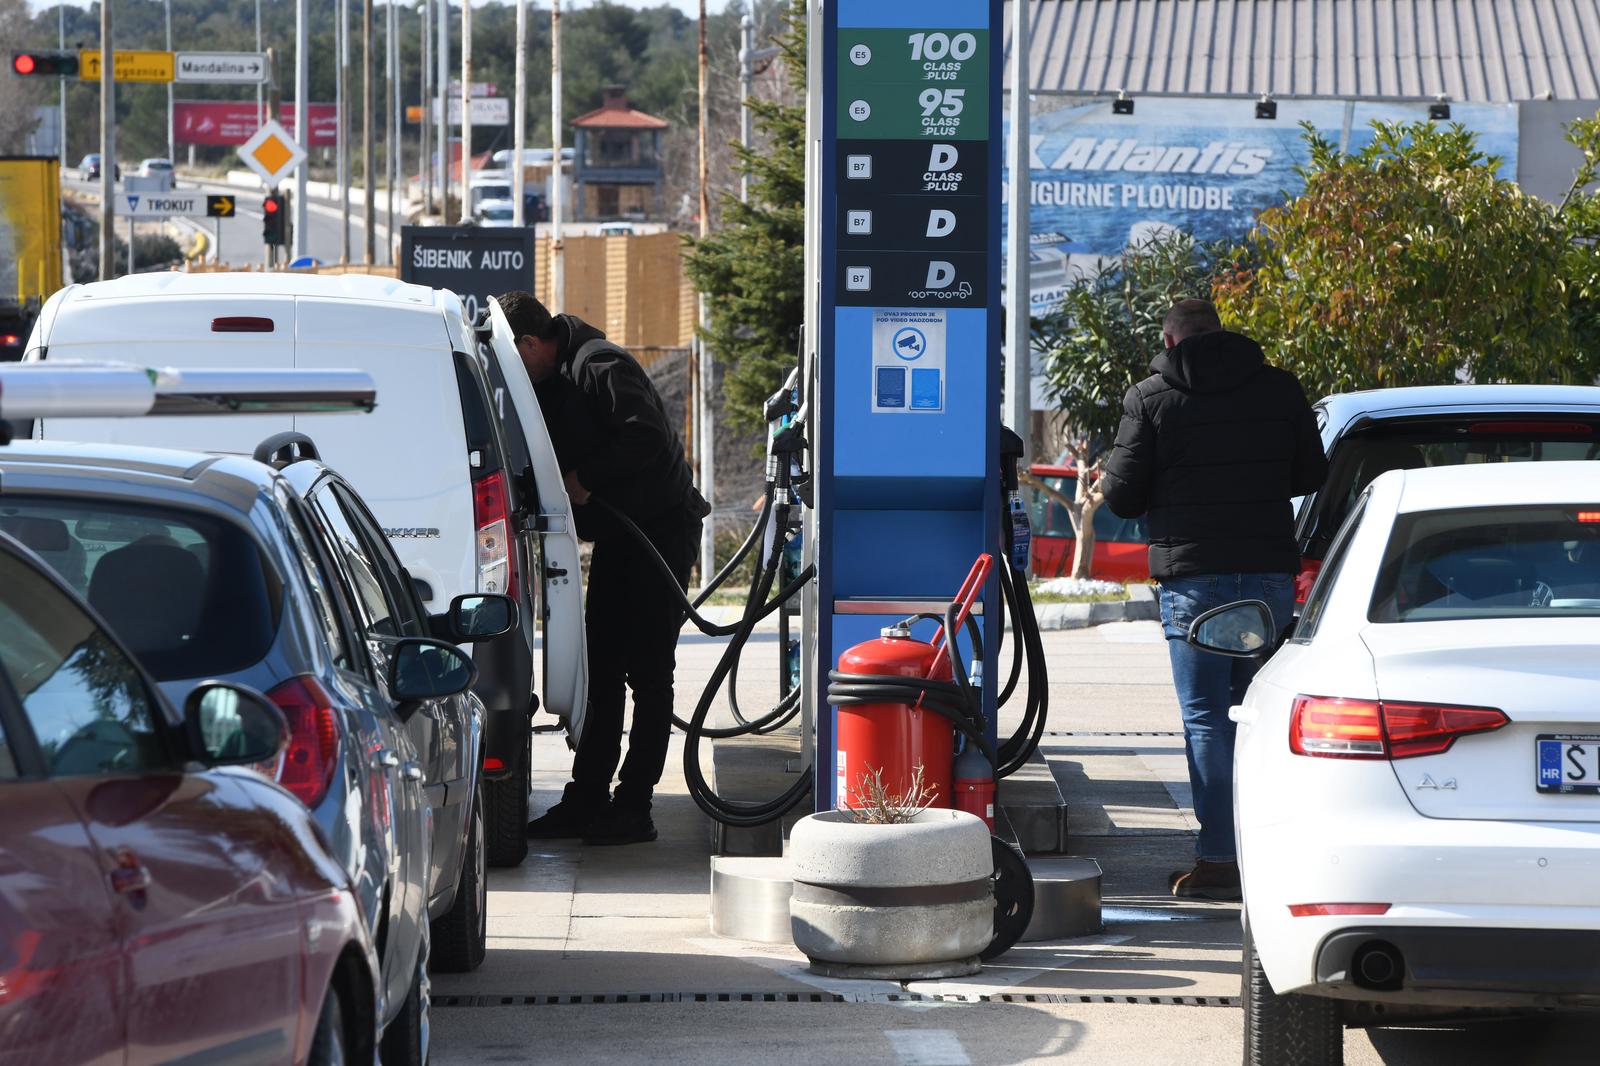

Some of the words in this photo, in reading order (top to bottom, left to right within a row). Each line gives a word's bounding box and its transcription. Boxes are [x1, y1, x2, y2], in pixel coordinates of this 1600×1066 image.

[908, 32, 977, 61] 100
[855, 51, 866, 59] E5
[182, 62, 244, 74] Mandalina
[923, 62, 961, 71] CLASS
[927, 71, 957, 80] PLUS
[918, 88, 965, 117] 95
[854, 106, 865, 114] E5
[921, 117, 960, 126] CLASS
[925, 127, 956, 136] PLUS
[928, 144, 958, 172] D
[1052, 138, 1271, 174] Atlantis
[853, 163, 865, 171] B7
[923, 172, 962, 181] CLASS
[927, 182, 958, 191] PLUS
[1030, 182, 1115, 207] IGURNE
[1121, 184, 1234, 210] PLOVIDBE
[148, 199, 194, 212] TROKUT
[853, 218, 865, 226] B7
[926, 209, 956, 237] D
[413, 244, 472, 269] ŠIBENIK
[480, 250, 524, 270] AUTO
[852, 275, 864, 283] B7
[925, 261, 956, 288] D
[382, 528, 440, 538] OKKER
[1542, 768, 1561, 779] HR
[1416, 772, 1458, 791] A4
